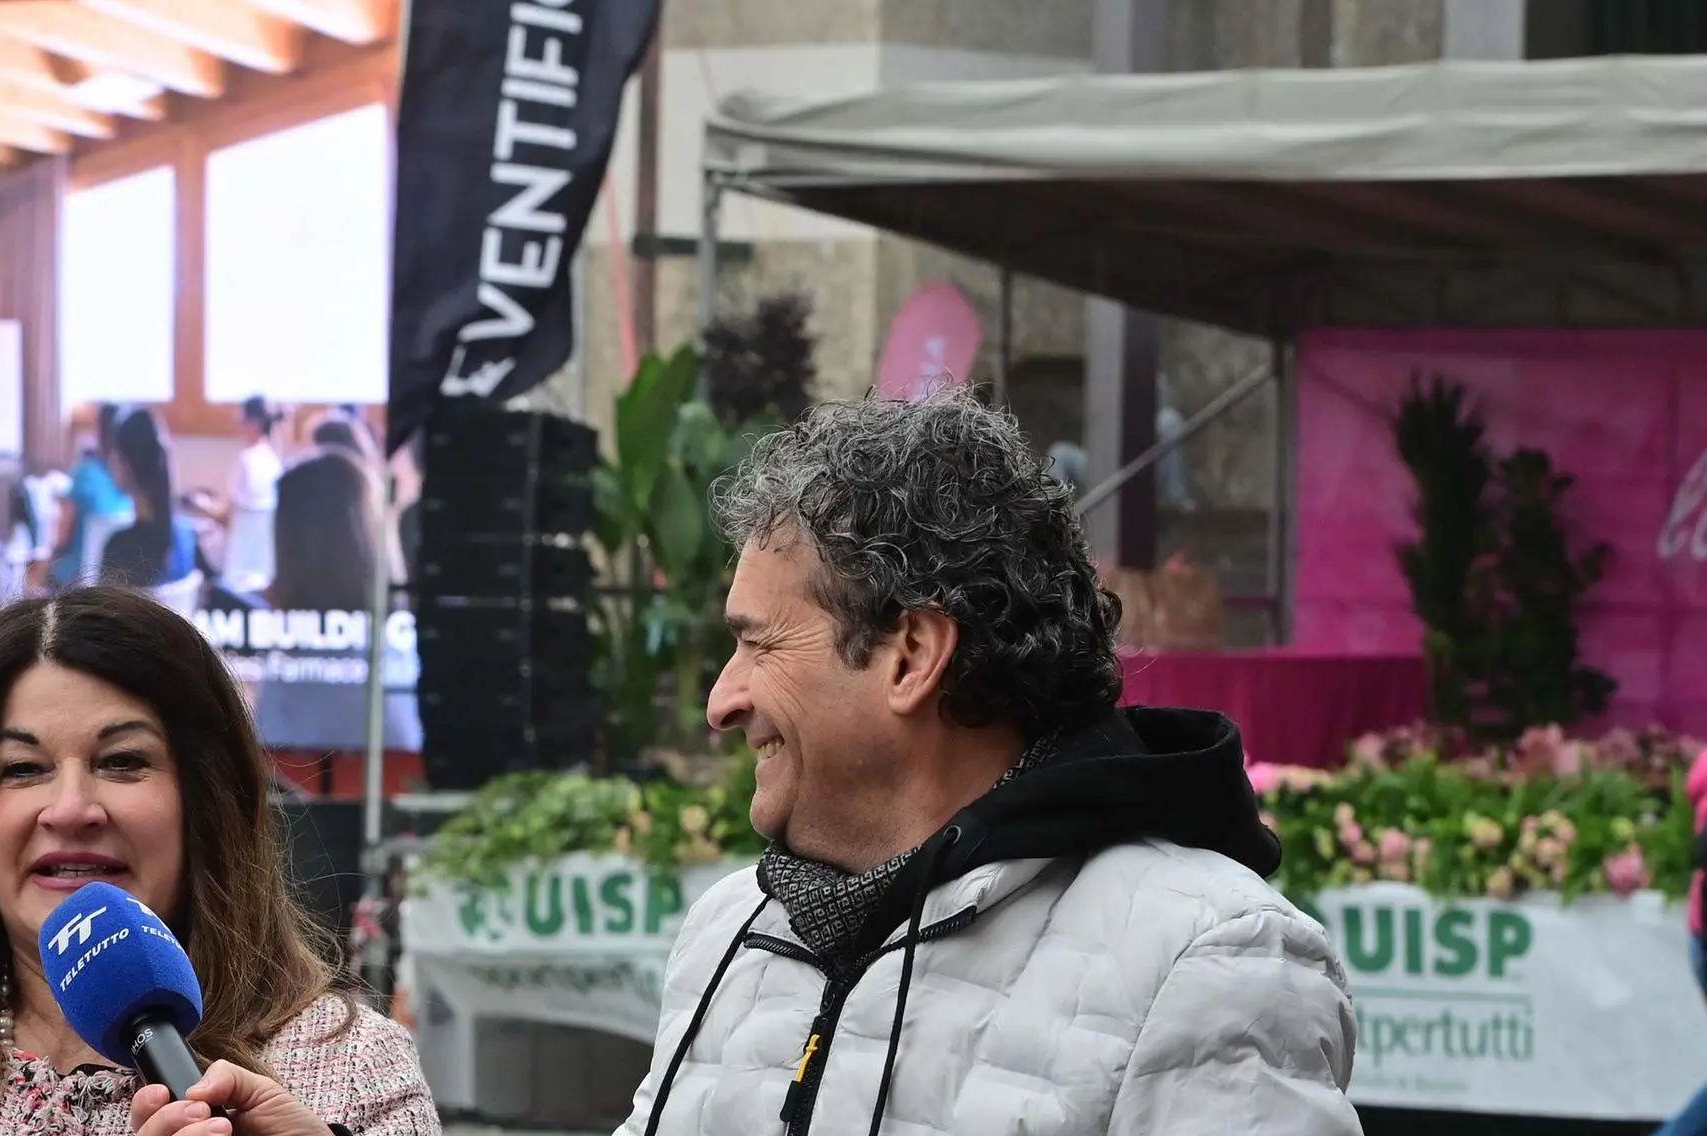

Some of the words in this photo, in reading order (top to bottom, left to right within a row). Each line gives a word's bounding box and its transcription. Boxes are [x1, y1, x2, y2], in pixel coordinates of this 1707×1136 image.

[439, 0, 584, 398] EVENTIFI
[247, 608, 417, 652] BUILDIG
[524, 870, 684, 938] UISP
[59, 927, 130, 992] TELETUTTO
[1343, 906, 1533, 979] UISP
[1355, 1004, 1535, 1068] tpertutti
